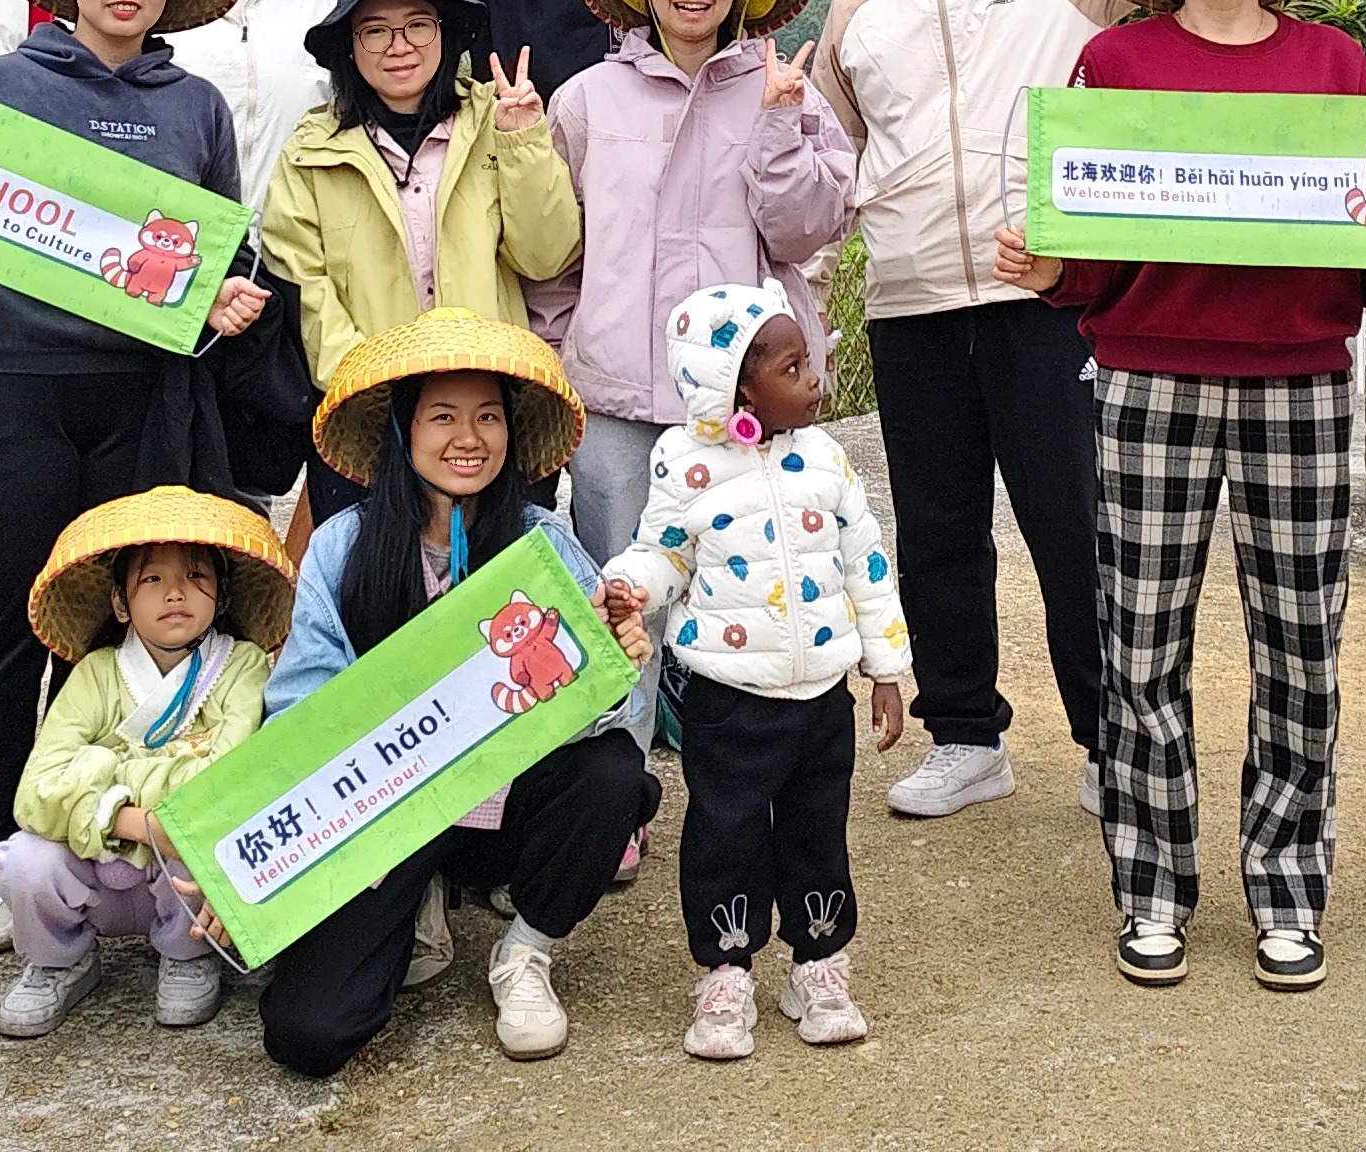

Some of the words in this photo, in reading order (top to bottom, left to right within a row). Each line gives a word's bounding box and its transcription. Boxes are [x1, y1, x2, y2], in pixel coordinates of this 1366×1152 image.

[1061, 186, 1135, 201] Welcome
[1140, 189, 1156, 202] to
[1160, 189, 1217, 204] Beihai!
[1239, 170, 1284, 188] huān
[1291, 172, 1329, 192] yíng
[3, 217, 22, 234] to
[25, 226, 93, 263] Culture
[252, 842, 308, 889] Hello!
[306, 812, 354, 849] Hola!
[354, 756, 427, 815] Bonjour!
